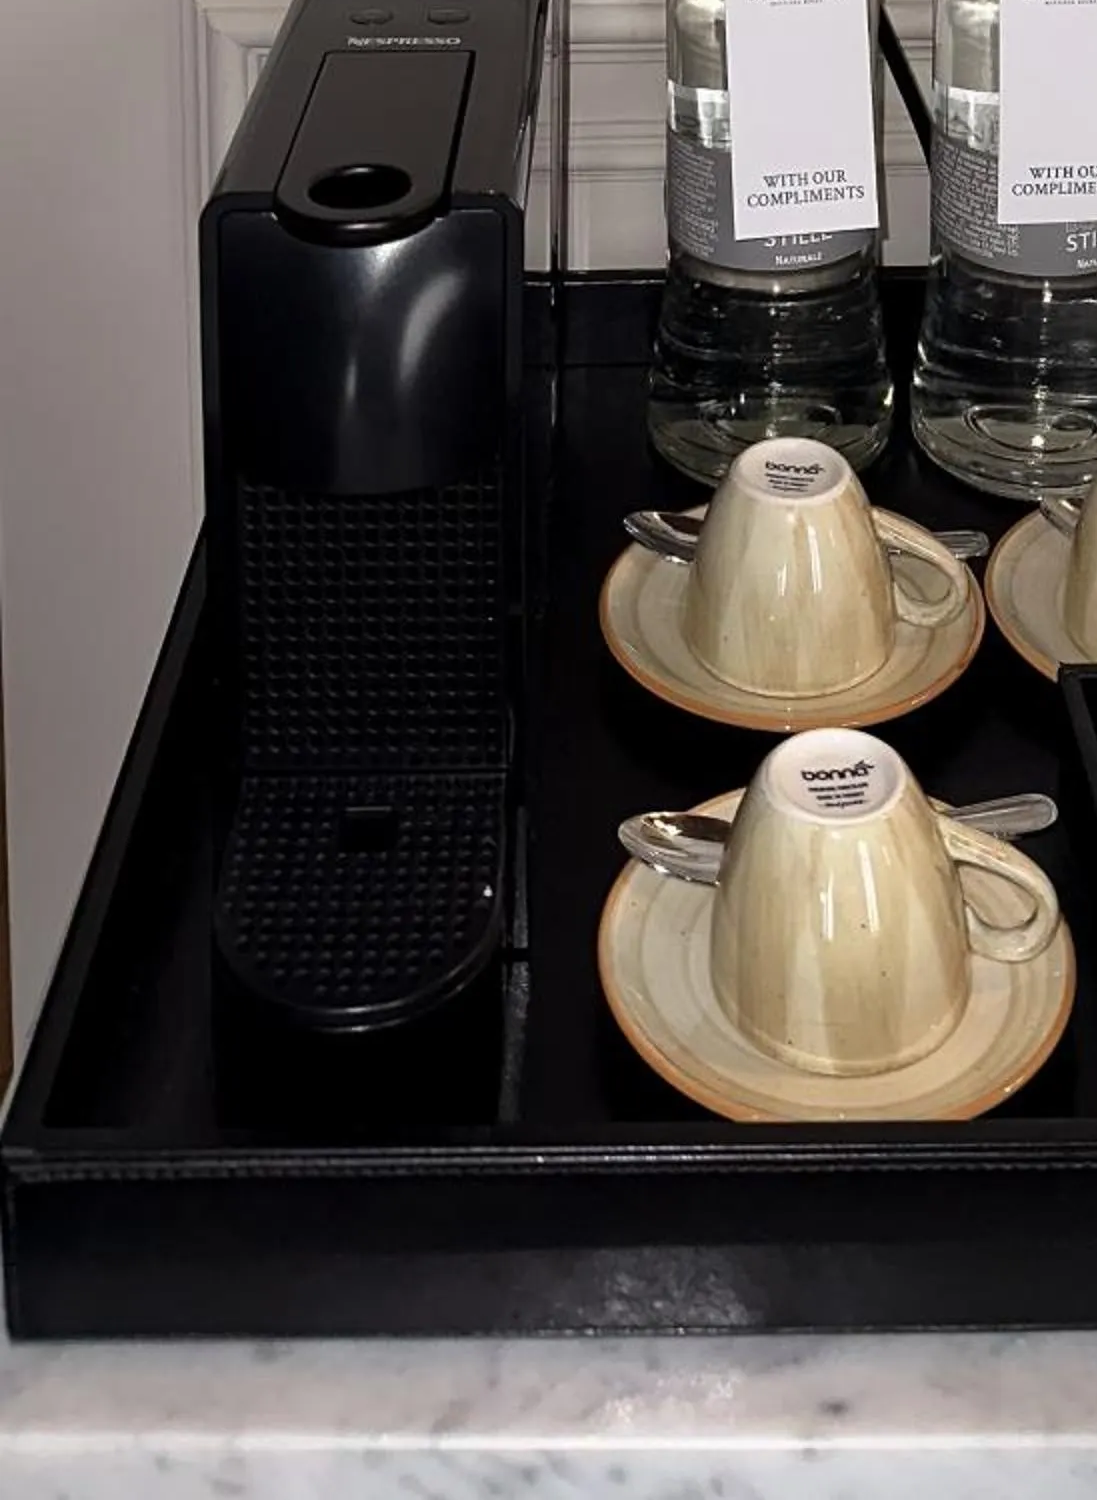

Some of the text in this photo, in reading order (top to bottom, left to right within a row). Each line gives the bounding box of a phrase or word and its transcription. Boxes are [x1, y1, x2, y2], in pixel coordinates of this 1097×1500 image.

[763, 169, 847, 188] WITH OUR
[1029, 165, 1074, 179] WITH
[747, 185, 865, 208] COMPLIMENTS
